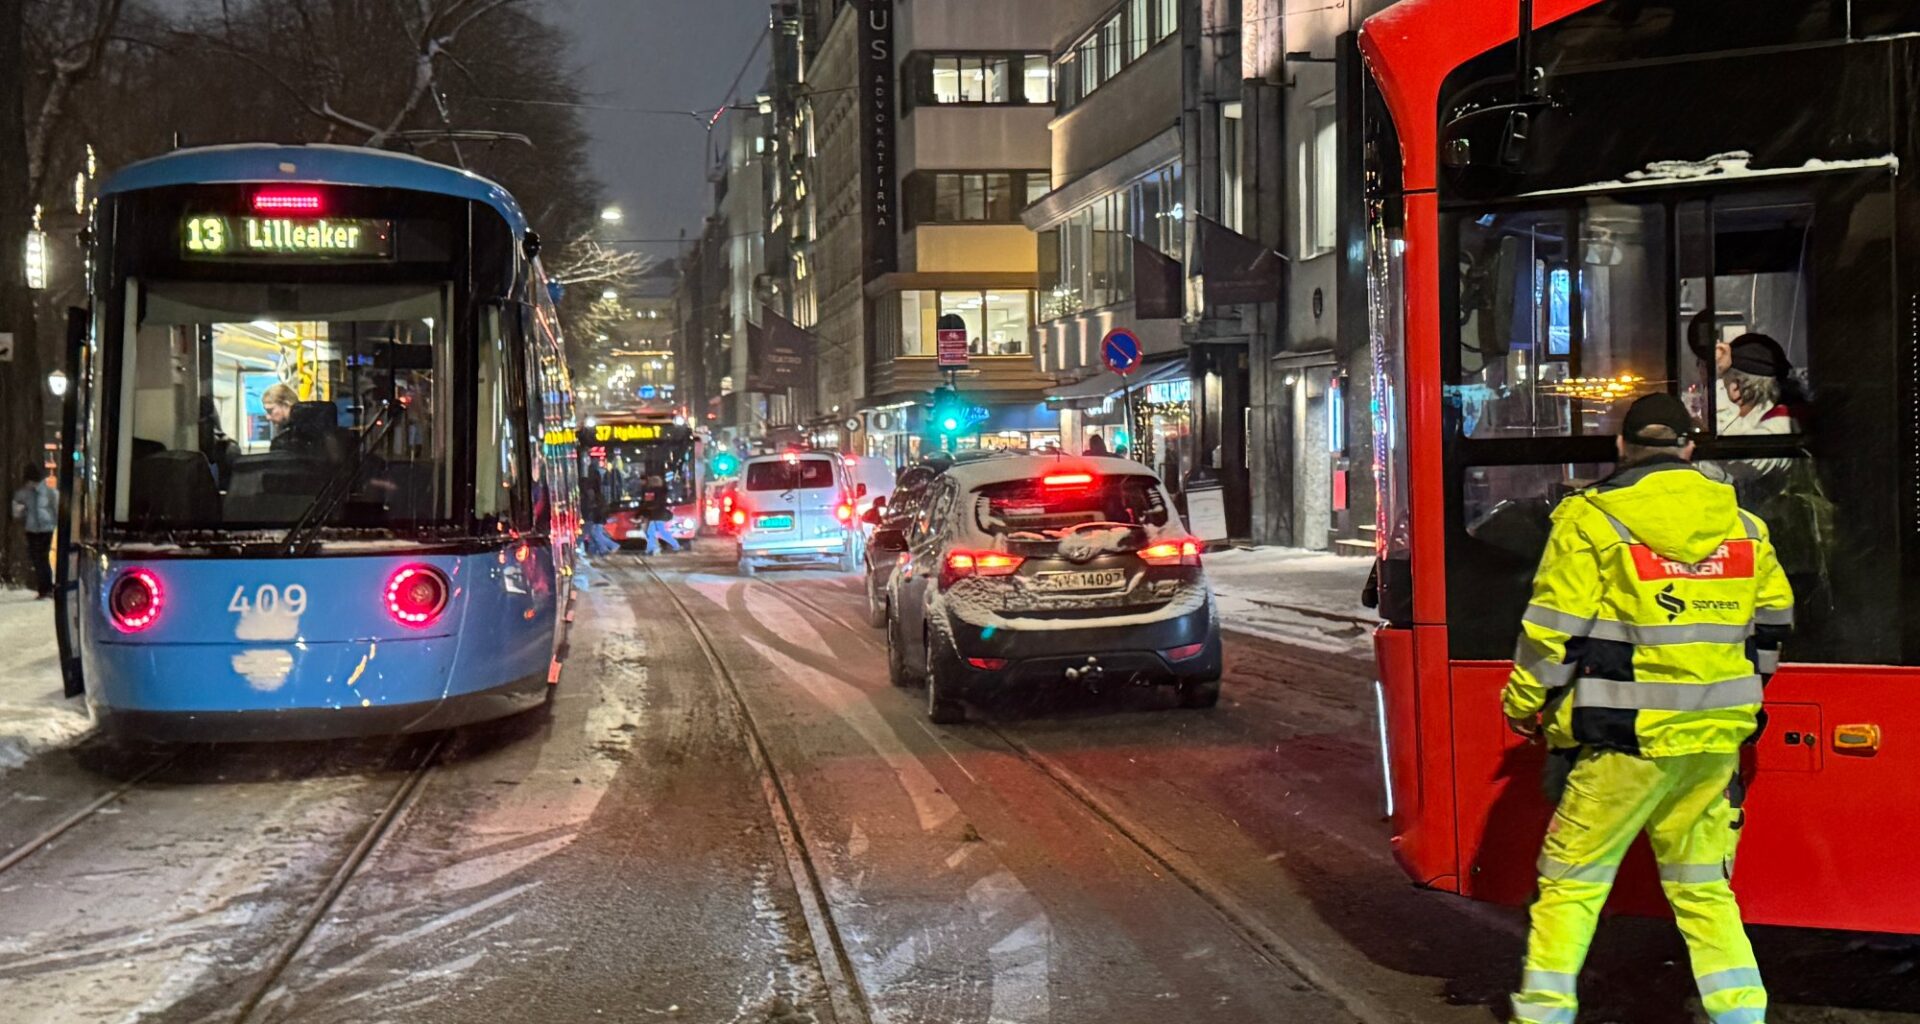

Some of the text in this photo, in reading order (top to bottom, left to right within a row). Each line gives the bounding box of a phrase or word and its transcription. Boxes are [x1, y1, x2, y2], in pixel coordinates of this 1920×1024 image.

[869, 0, 887, 226] US ADVOKATFIRMA
[188, 218, 358, 250] 13 Lilleaker
[595, 425, 611, 441] 37
[1080, 572, 1121, 587] 14097
[227, 584, 307, 618] 409
